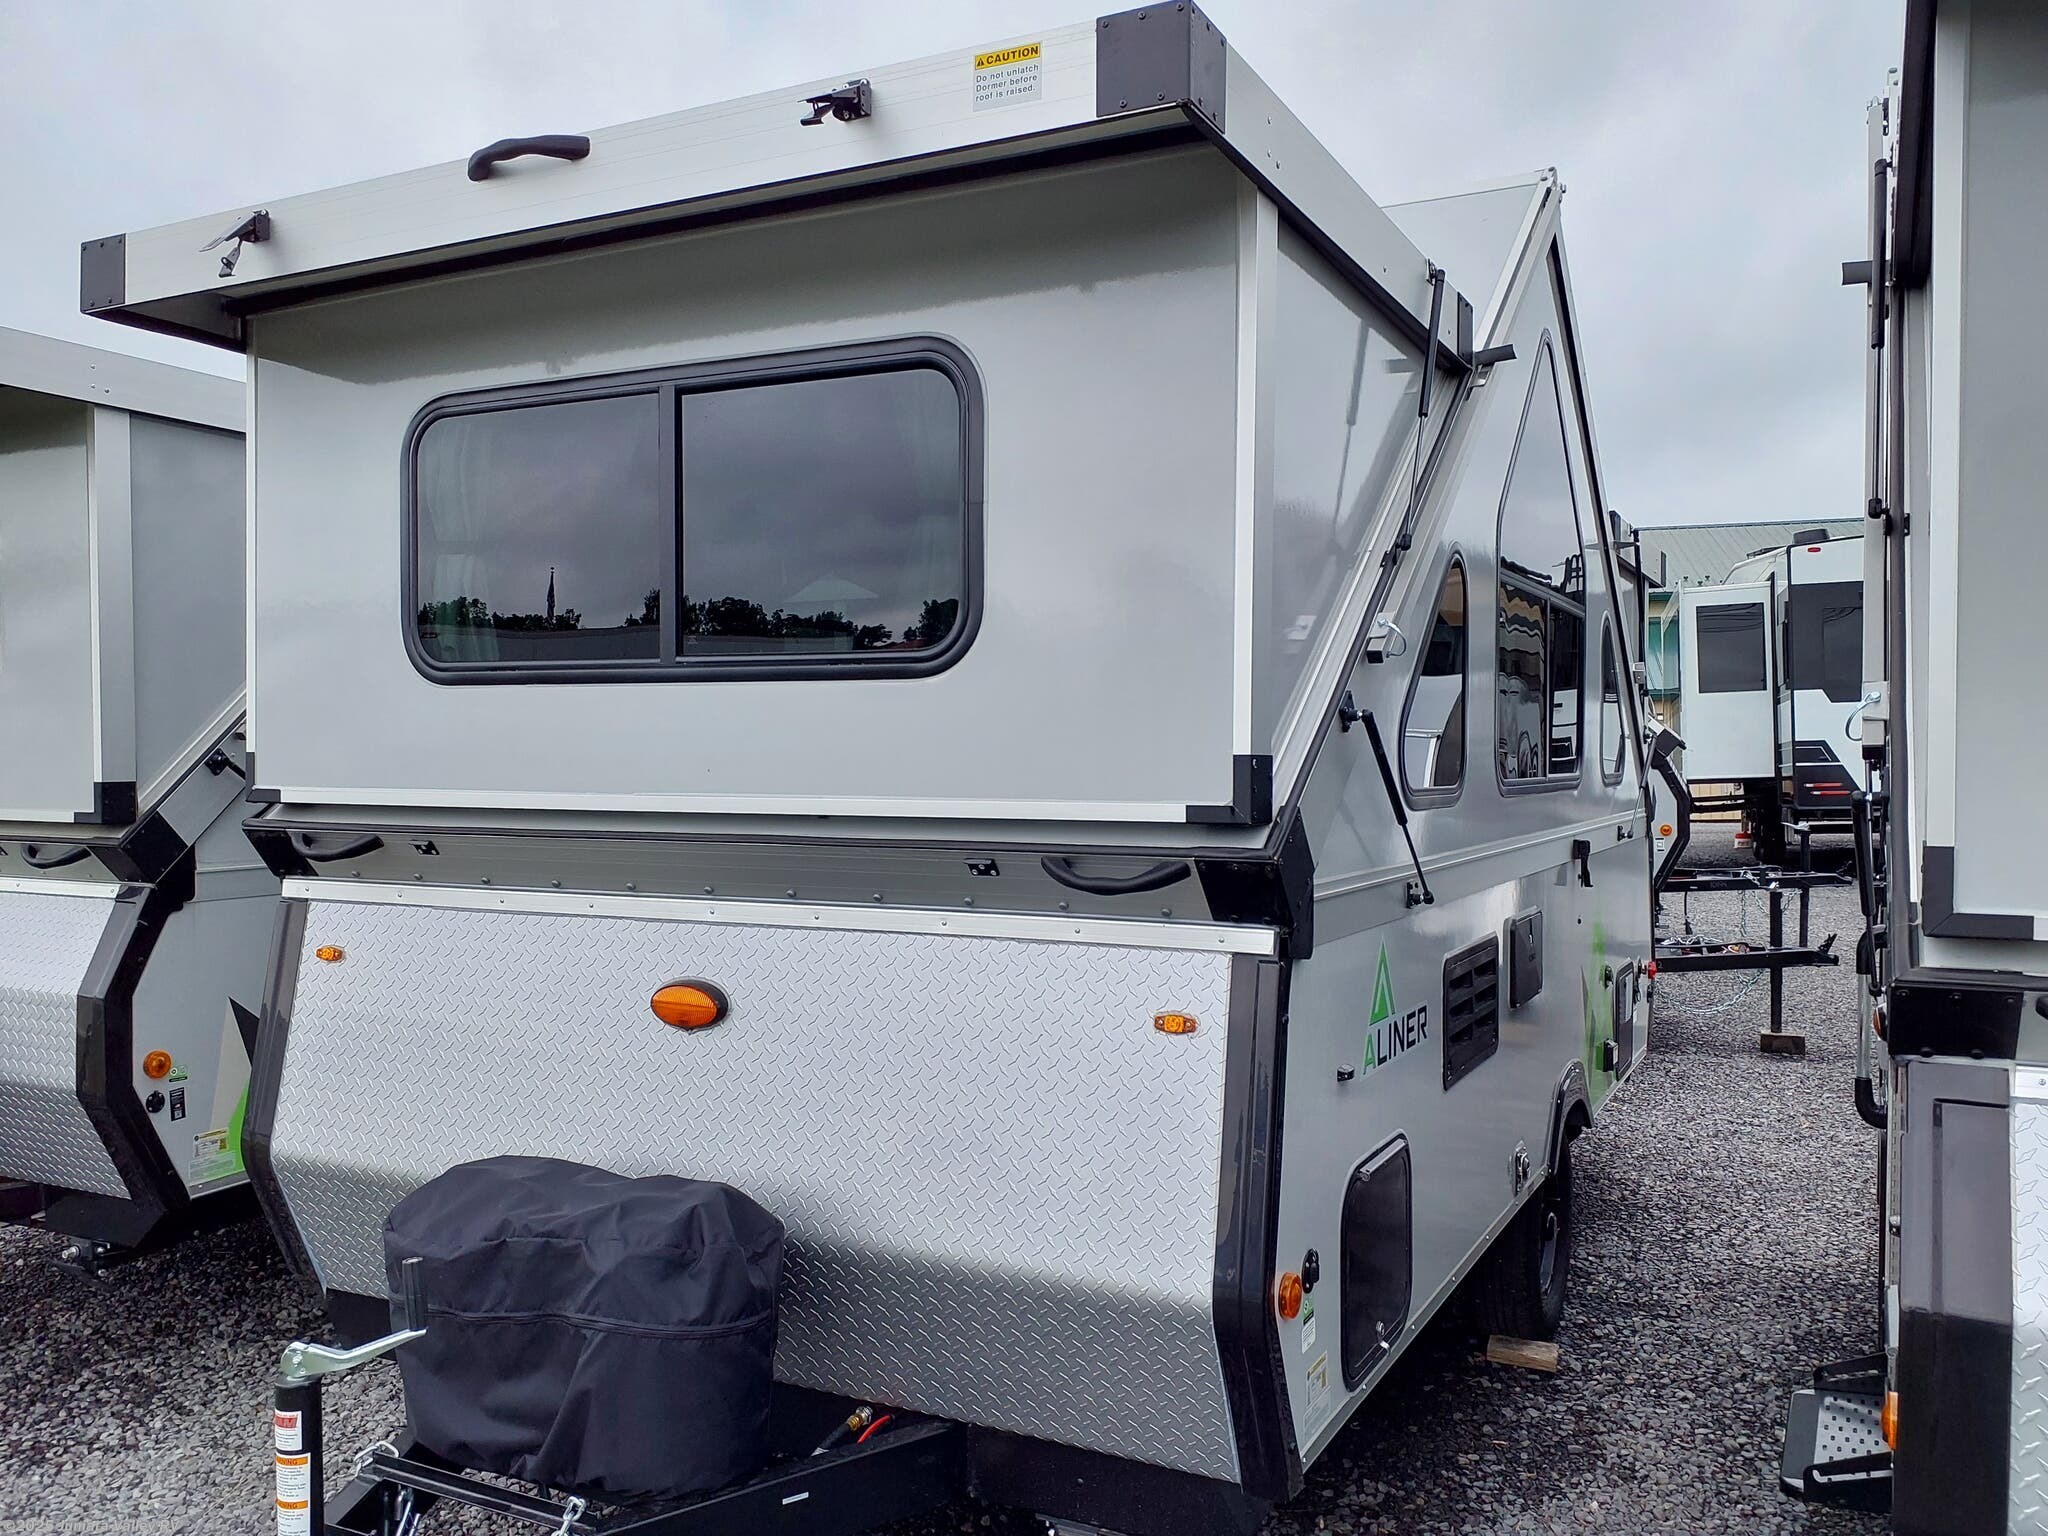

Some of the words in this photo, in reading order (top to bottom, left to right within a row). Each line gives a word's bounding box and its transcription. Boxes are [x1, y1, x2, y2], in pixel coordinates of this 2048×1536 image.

[986, 46, 1039, 65] CAUTION
[976, 75, 987, 83] Do
[1006, 64, 1039, 76] unlatch
[975, 91, 993, 102] roof
[996, 90, 1003, 98] is
[1006, 84, 1036, 96] raised.
[976, 80, 1007, 93] Dormer
[1009, 74, 1037, 86] before
[1363, 1004, 1428, 1076] ALINER
